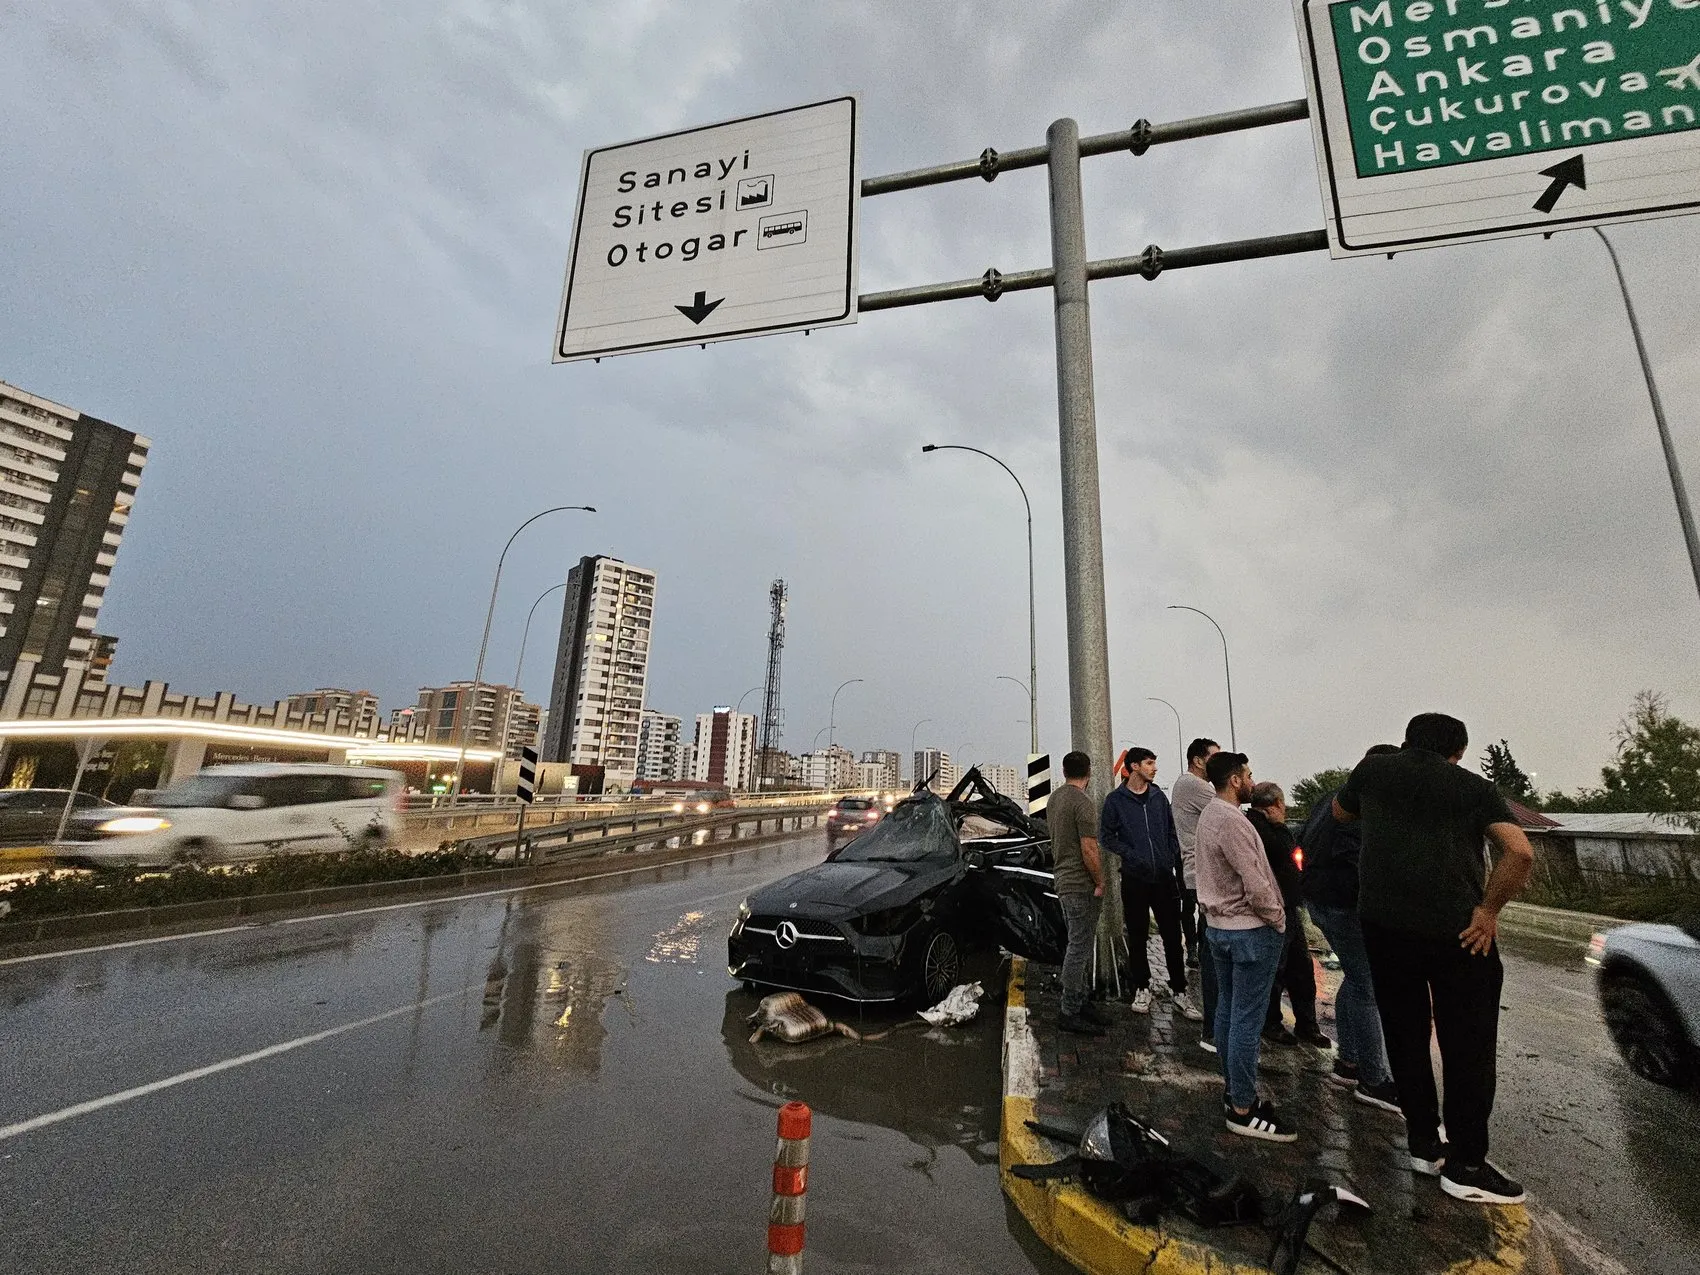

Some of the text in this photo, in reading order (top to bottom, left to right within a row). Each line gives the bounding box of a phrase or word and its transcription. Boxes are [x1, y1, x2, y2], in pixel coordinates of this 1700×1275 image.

[1350, 0, 1530, 33] Mer
[1366, 40, 1616, 101] Ankara
[1369, 71, 1649, 135] Çukurova
[1374, 104, 1696, 169] Havaliman
[617, 149, 750, 193] Sanayi
[612, 190, 727, 228] Sitesi
[606, 228, 748, 267] Otogar
